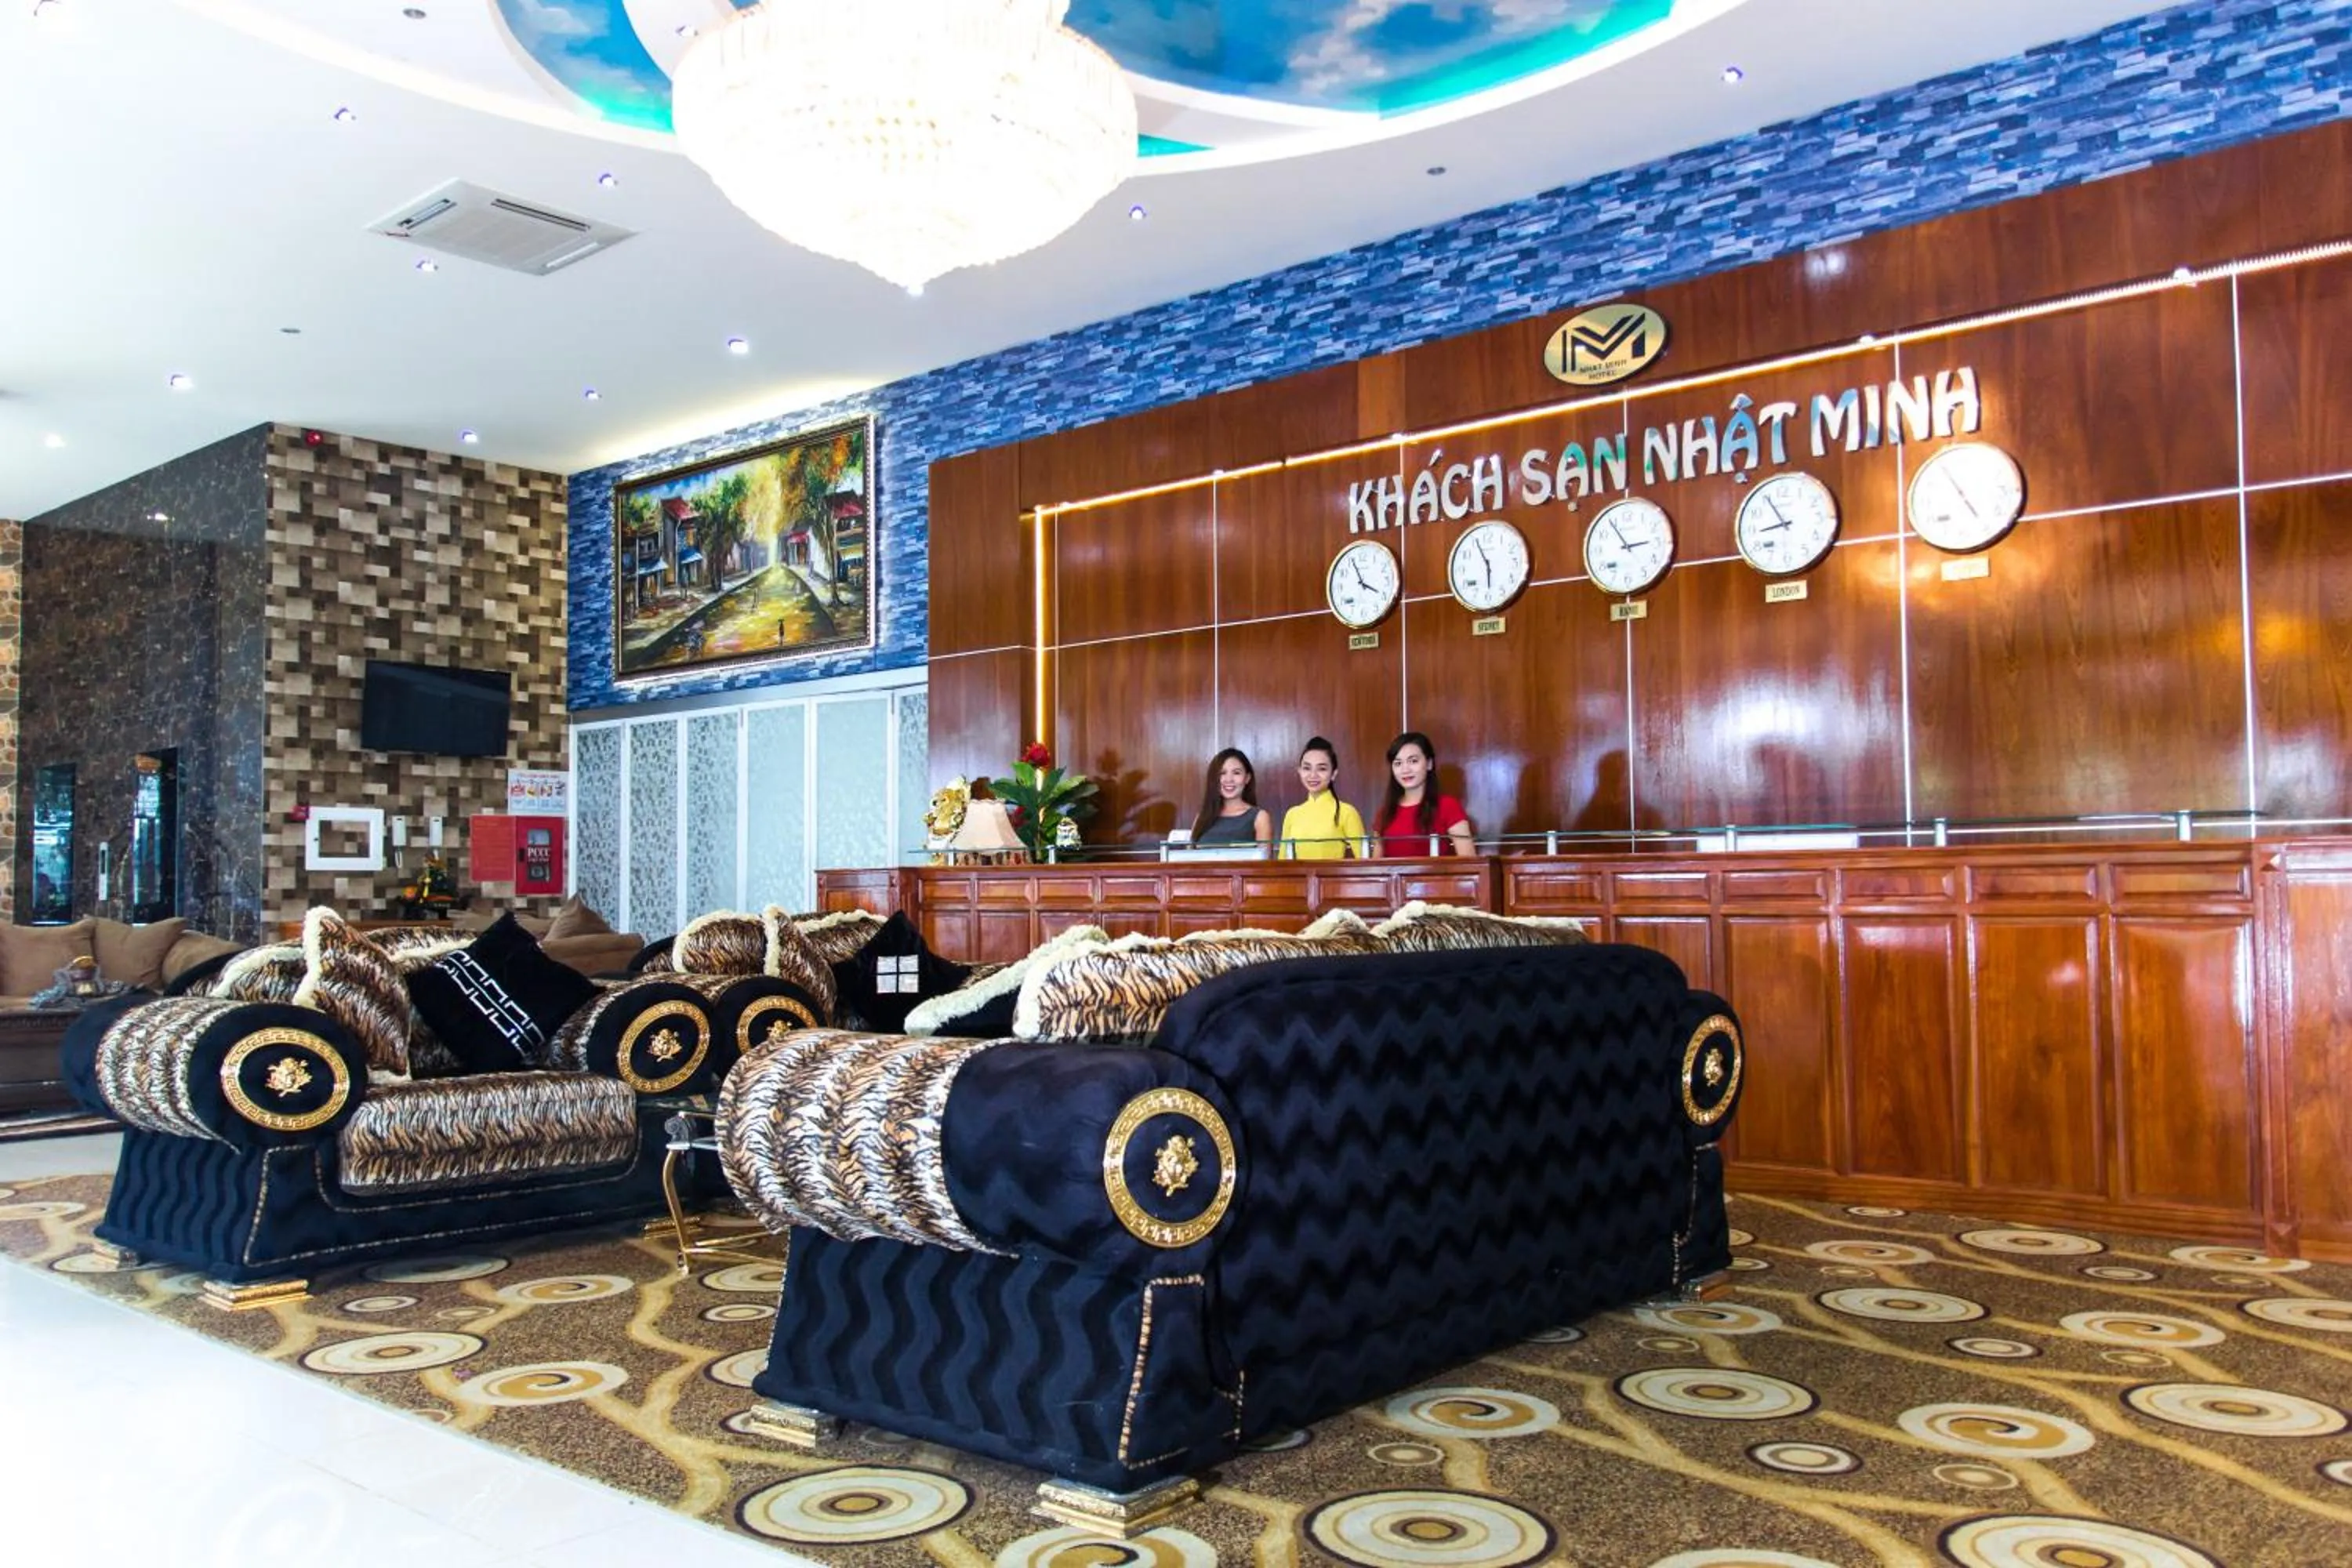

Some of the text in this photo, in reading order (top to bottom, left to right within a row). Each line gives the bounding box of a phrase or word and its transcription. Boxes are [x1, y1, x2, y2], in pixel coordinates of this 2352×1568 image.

[1349, 366, 1980, 534] KHÁCH SẠN NHẬT MINH
[1772, 585, 1801, 597] LONDON
[528, 847, 551, 857] PCCC
